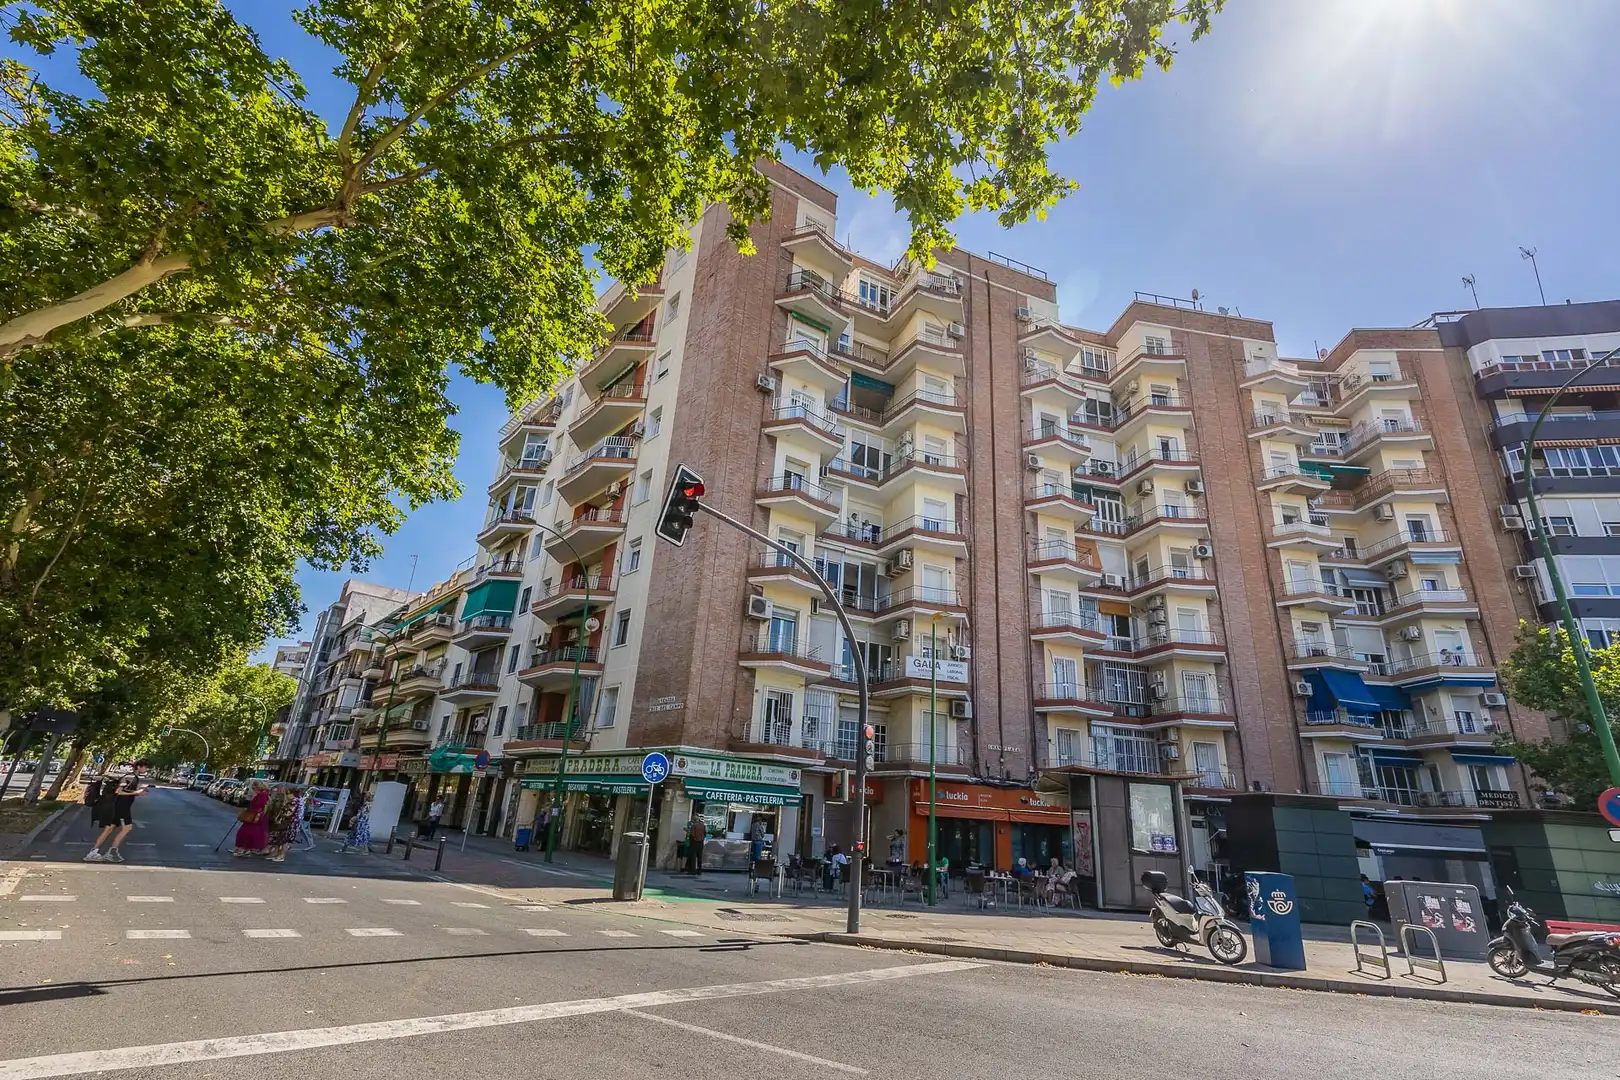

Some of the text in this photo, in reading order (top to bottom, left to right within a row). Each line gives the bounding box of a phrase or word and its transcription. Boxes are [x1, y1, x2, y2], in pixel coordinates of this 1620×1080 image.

[913, 659, 941, 670] GALA
[566, 759, 619, 772] PRADERA
[710, 761, 763, 780] LA PRADERA
[612, 786, 636, 794] PASTELERIA
[946, 791, 968, 800] luckia
